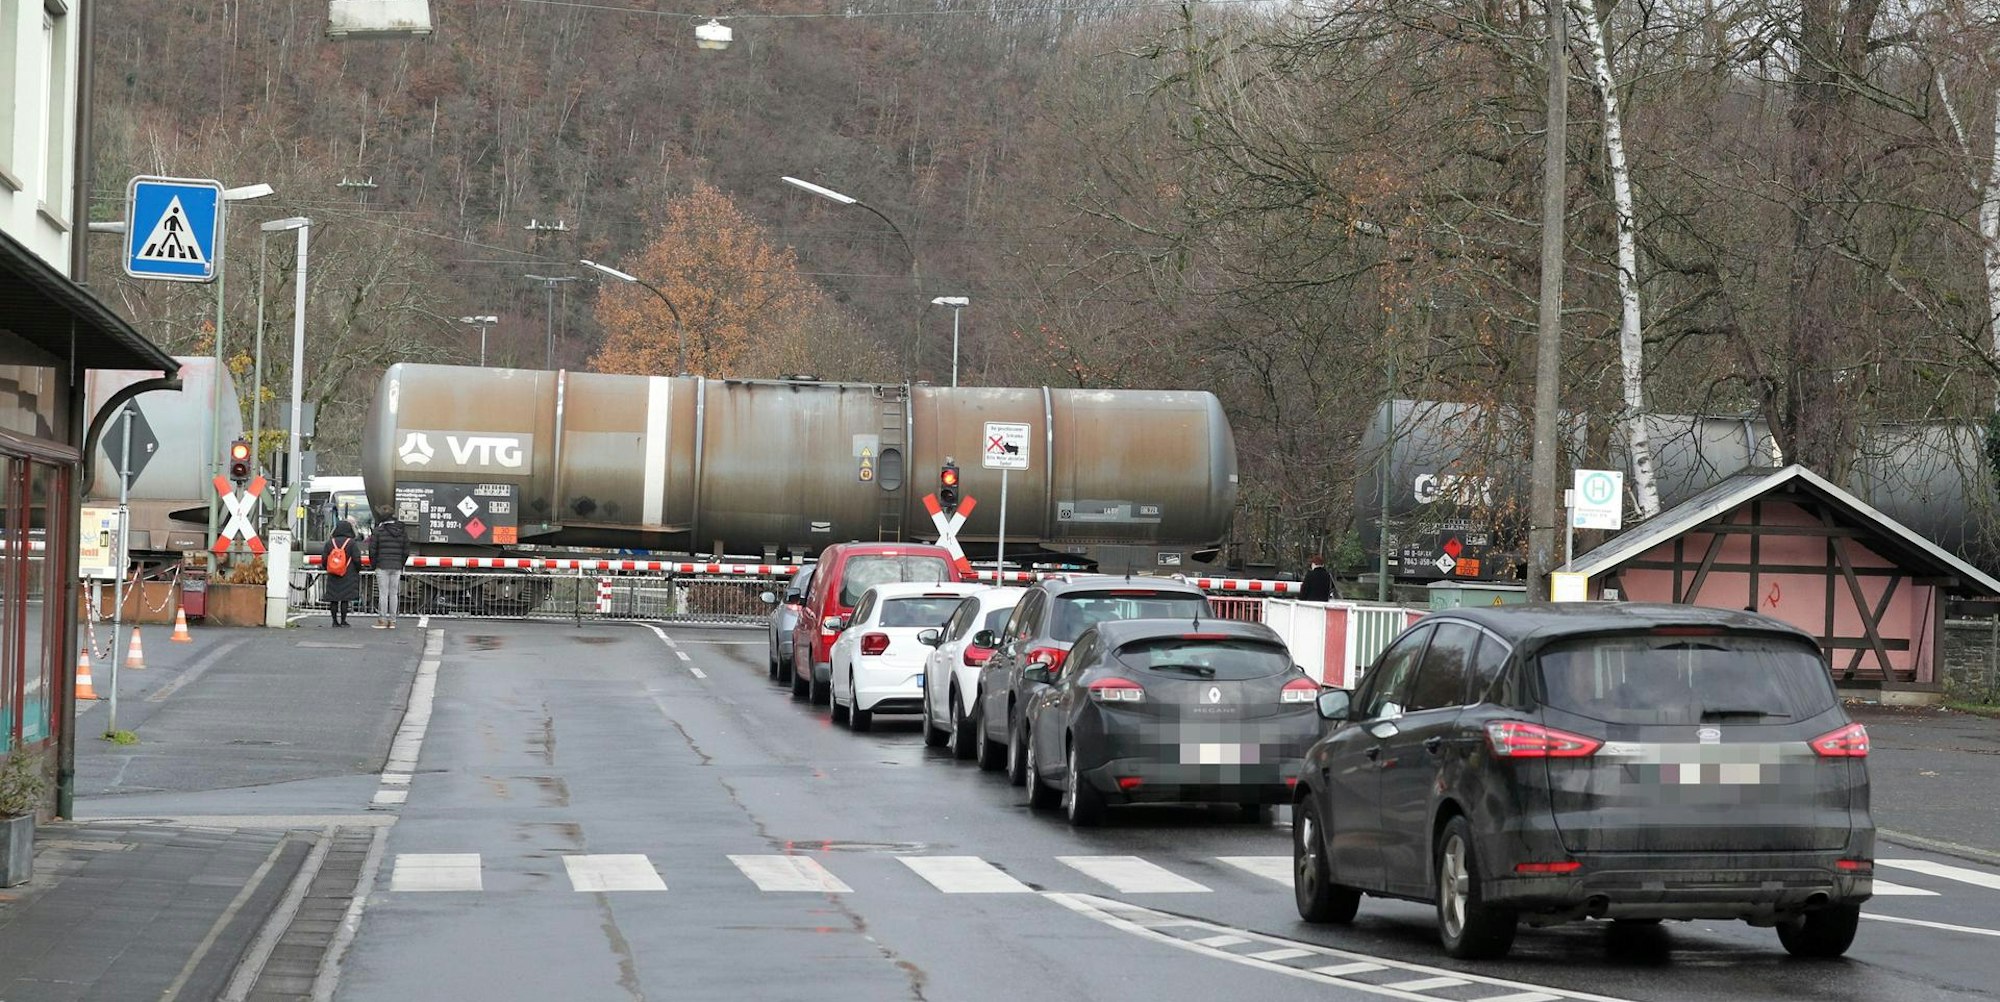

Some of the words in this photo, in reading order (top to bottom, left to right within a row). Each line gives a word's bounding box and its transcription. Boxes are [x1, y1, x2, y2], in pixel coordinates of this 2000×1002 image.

[446, 435, 523, 467] VTG
[1592, 479, 1605, 497] H
[430, 520, 444, 528] 7836
[446, 521, 461, 529] 097-1
